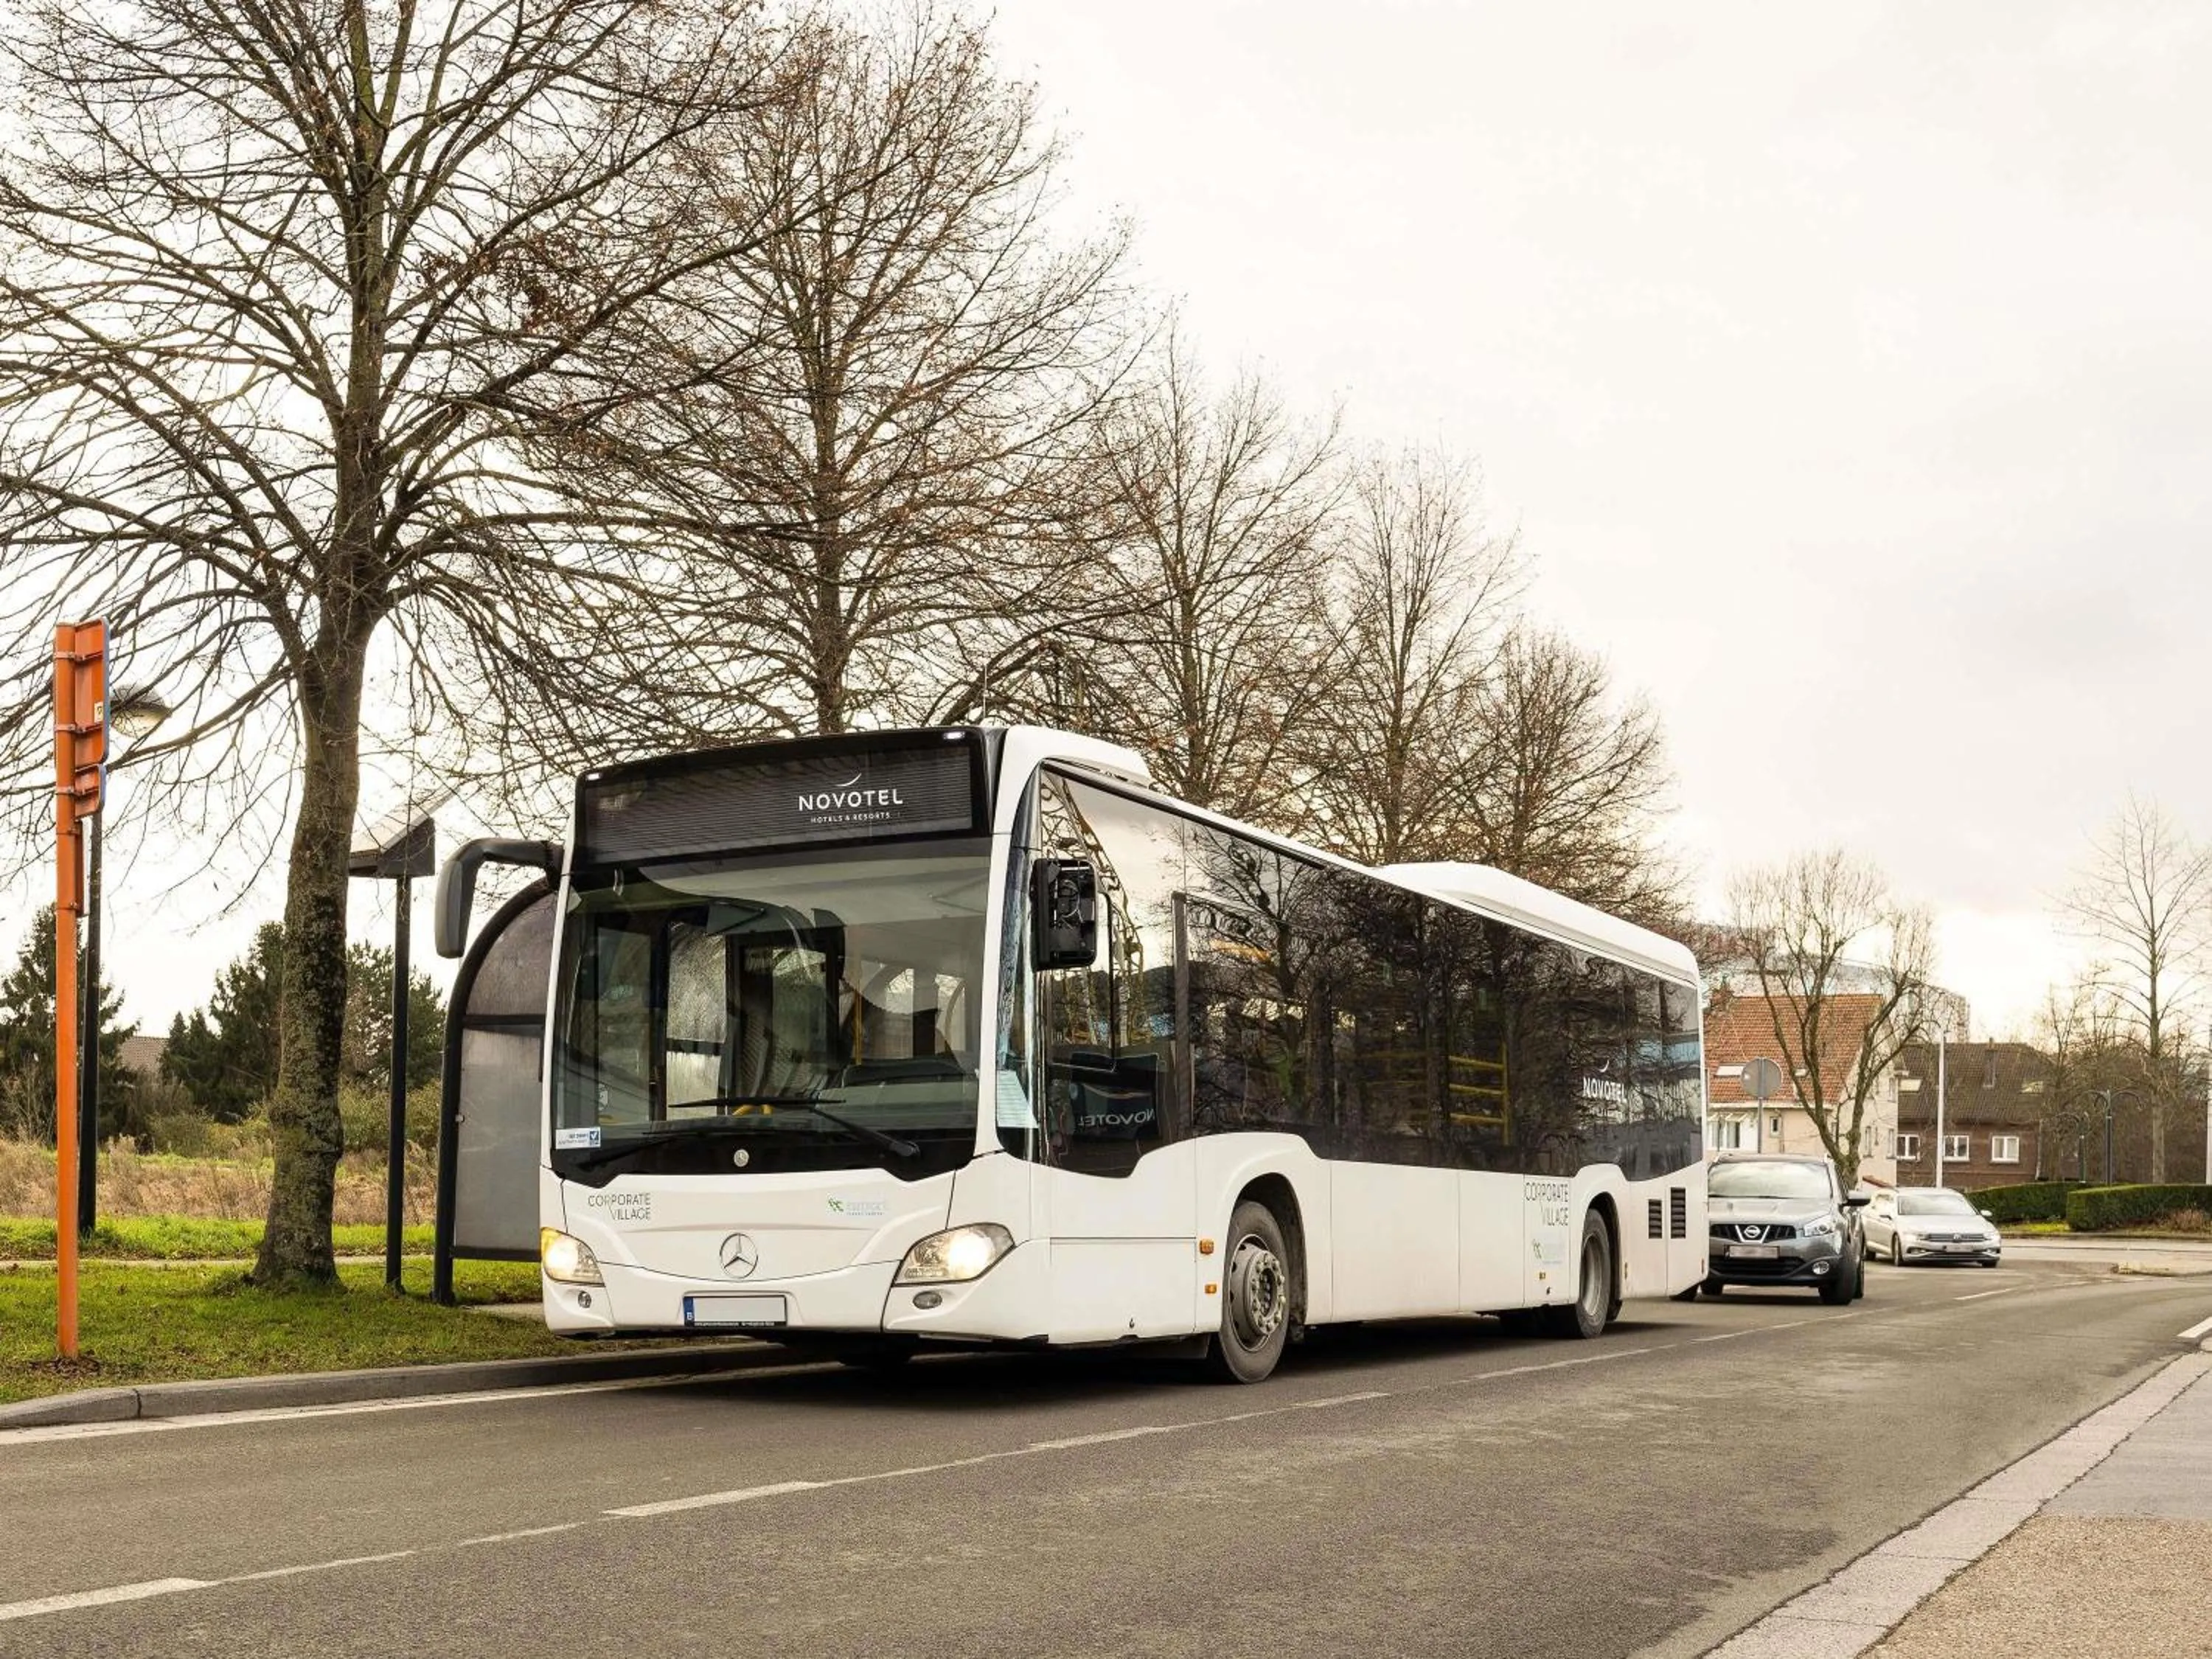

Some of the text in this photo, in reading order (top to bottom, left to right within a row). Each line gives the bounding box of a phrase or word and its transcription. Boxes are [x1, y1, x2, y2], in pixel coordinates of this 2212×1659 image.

[799, 789, 903, 811] NOVOTEL
[811, 815, 843, 824] HOTELS
[853, 812, 891, 821] RESORTS
[1582, 1077, 1627, 1104] NOVOTEL
[1524, 1182, 1568, 1203] CORPORATE
[588, 1193, 651, 1207] CORPORATE
[609, 1207, 651, 1220] VILLAGE
[686, 1312, 693, 1321] B
